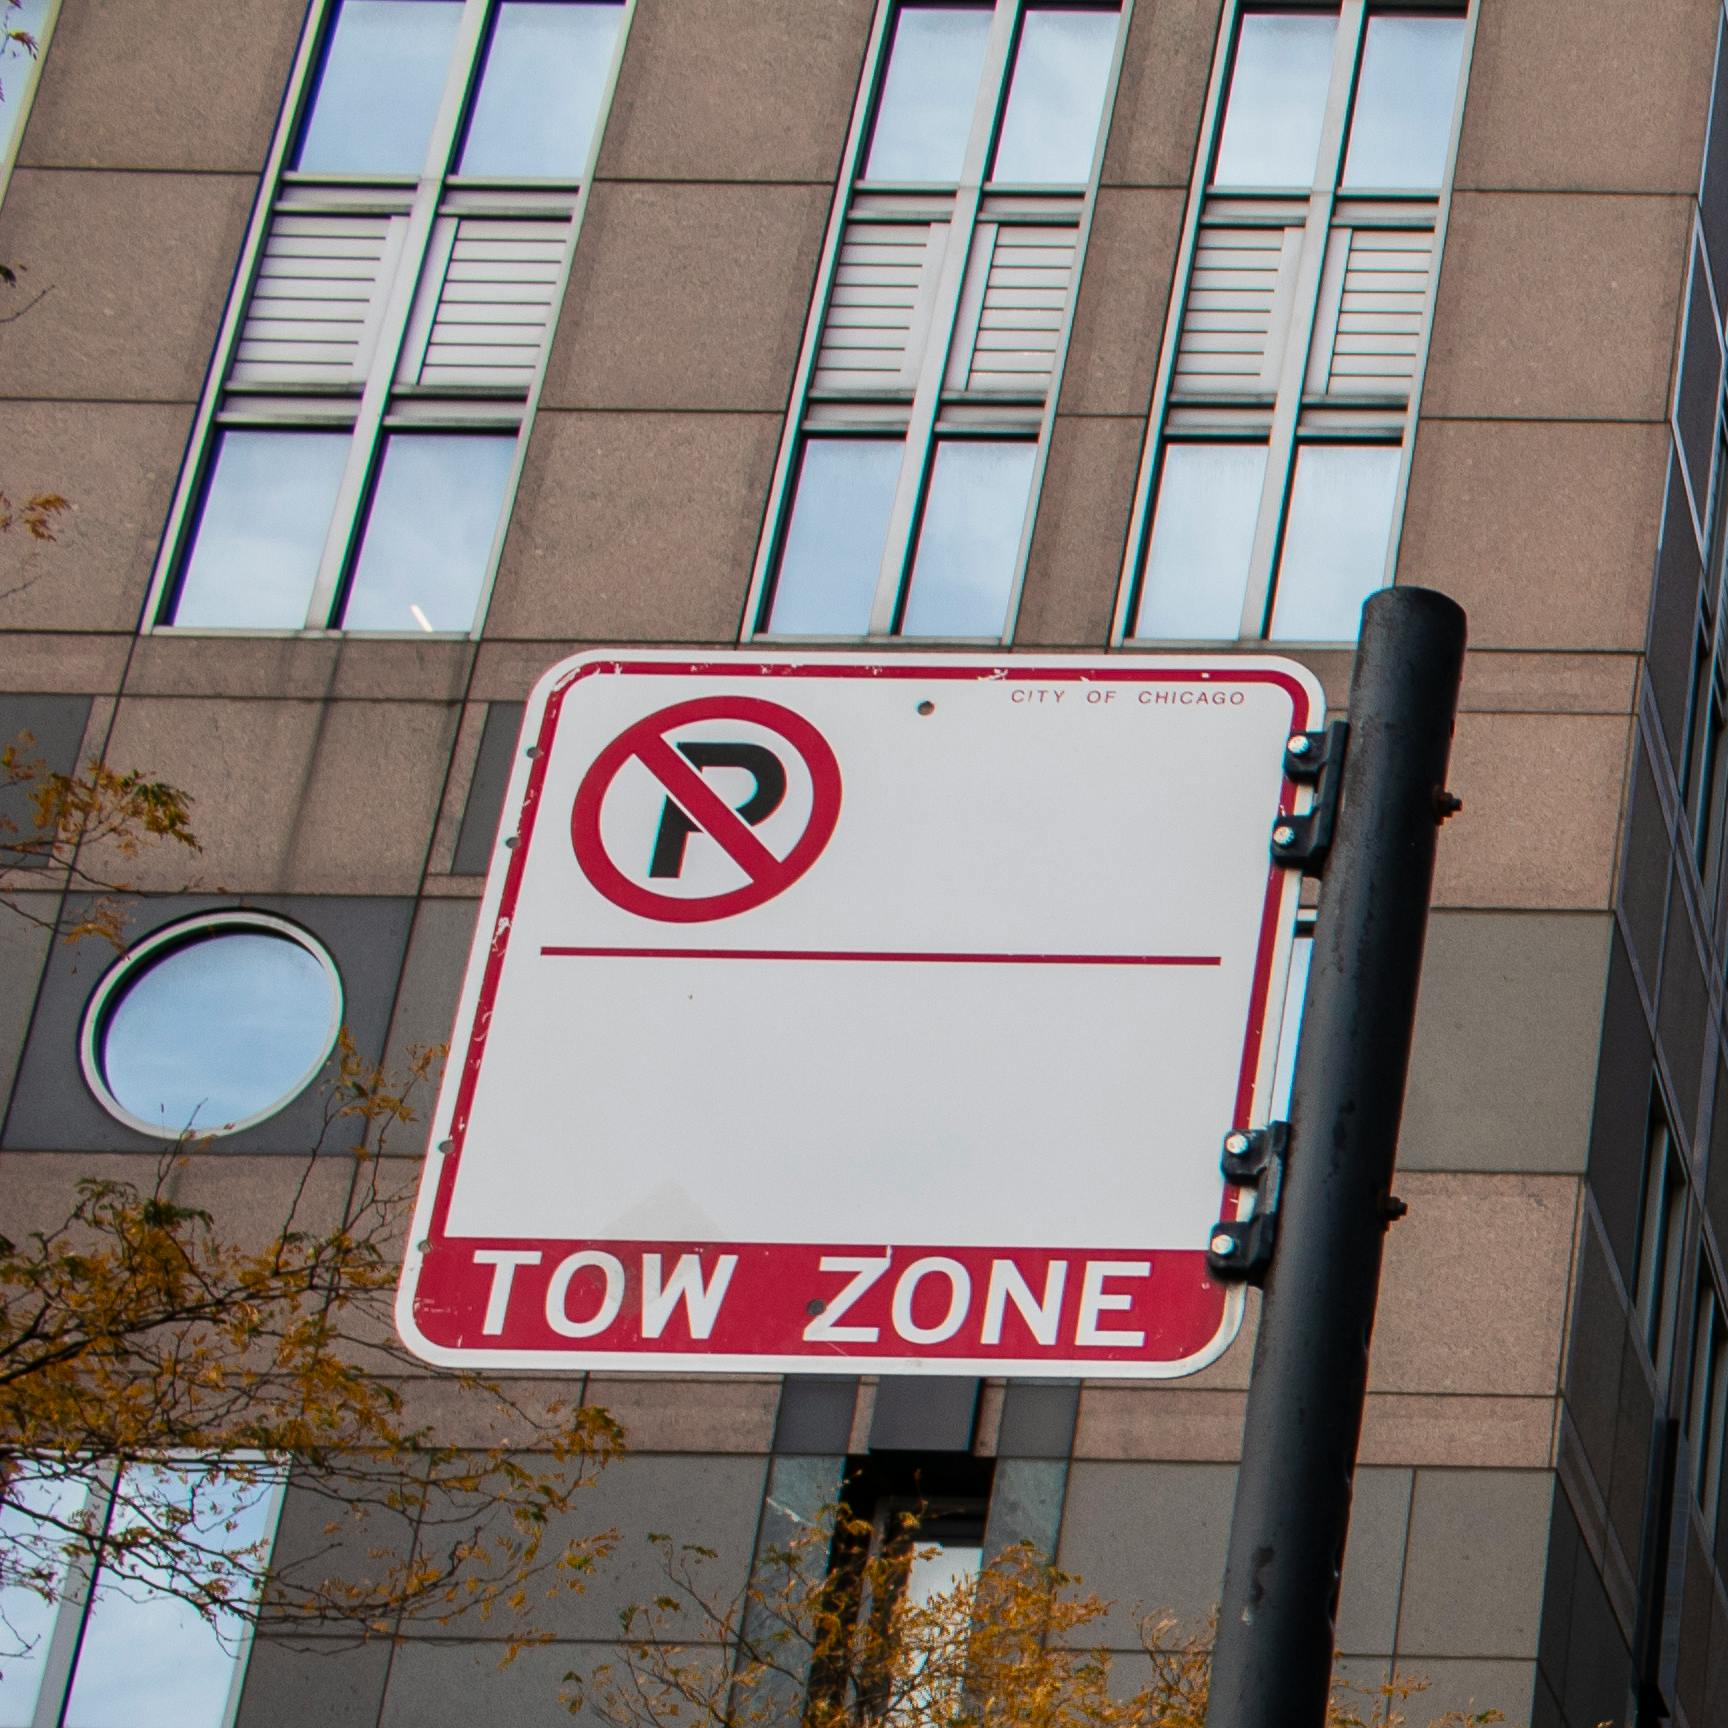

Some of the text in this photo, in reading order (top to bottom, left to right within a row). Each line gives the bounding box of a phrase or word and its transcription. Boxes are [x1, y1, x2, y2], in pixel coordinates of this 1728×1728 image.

[1011, 689, 1247, 706] CITY OF CHICAGO
[471, 1249, 1153, 1348] TOW ZONE
